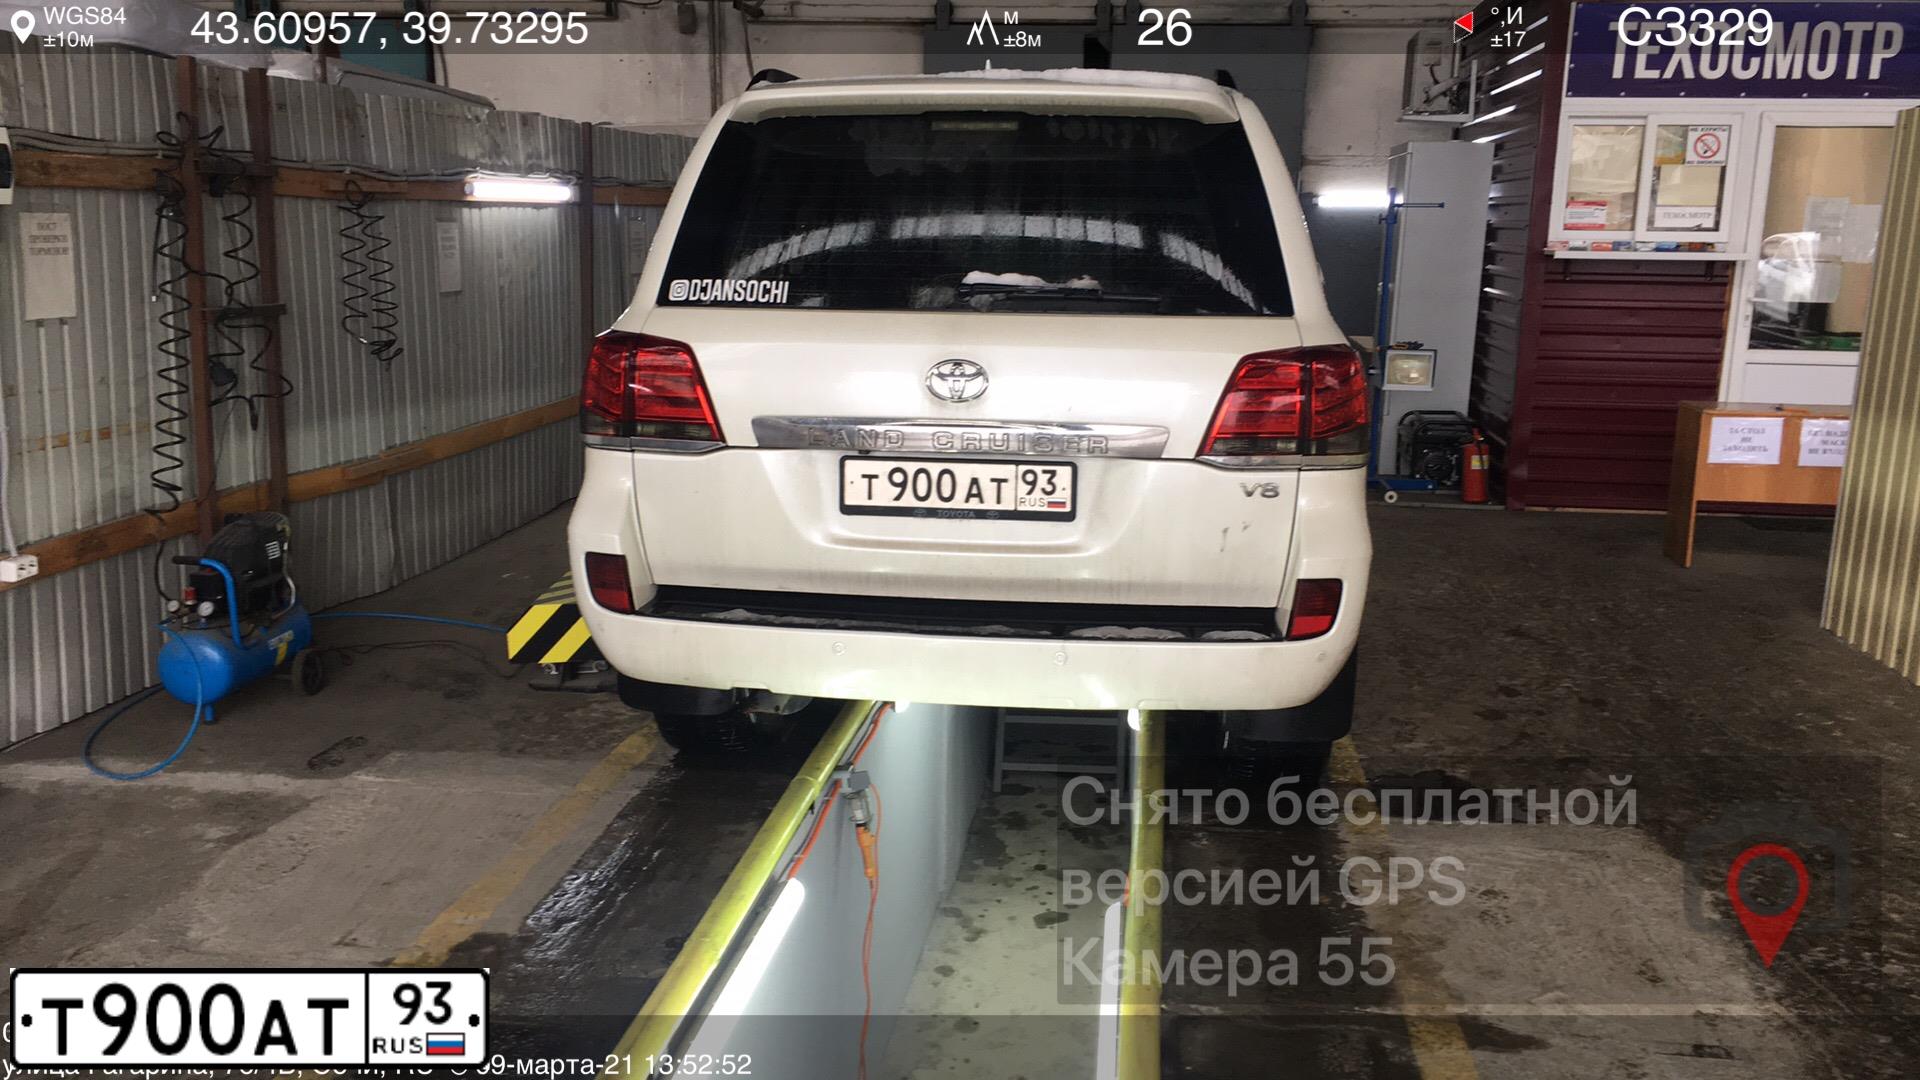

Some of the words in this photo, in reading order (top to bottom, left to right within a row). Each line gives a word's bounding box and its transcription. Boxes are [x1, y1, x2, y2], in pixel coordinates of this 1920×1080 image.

[1608, 21, 1904, 80] ТЕХОСМОТР
[807, 427, 904, 450] LAND
[931, 430, 1109, 455] CRUISER
[1021, 469, 1057, 496] 93
[1239, 482, 1280, 498] V8
[1018, 496, 1046, 508] RUS
[936, 509, 976, 519] TOYOTA
